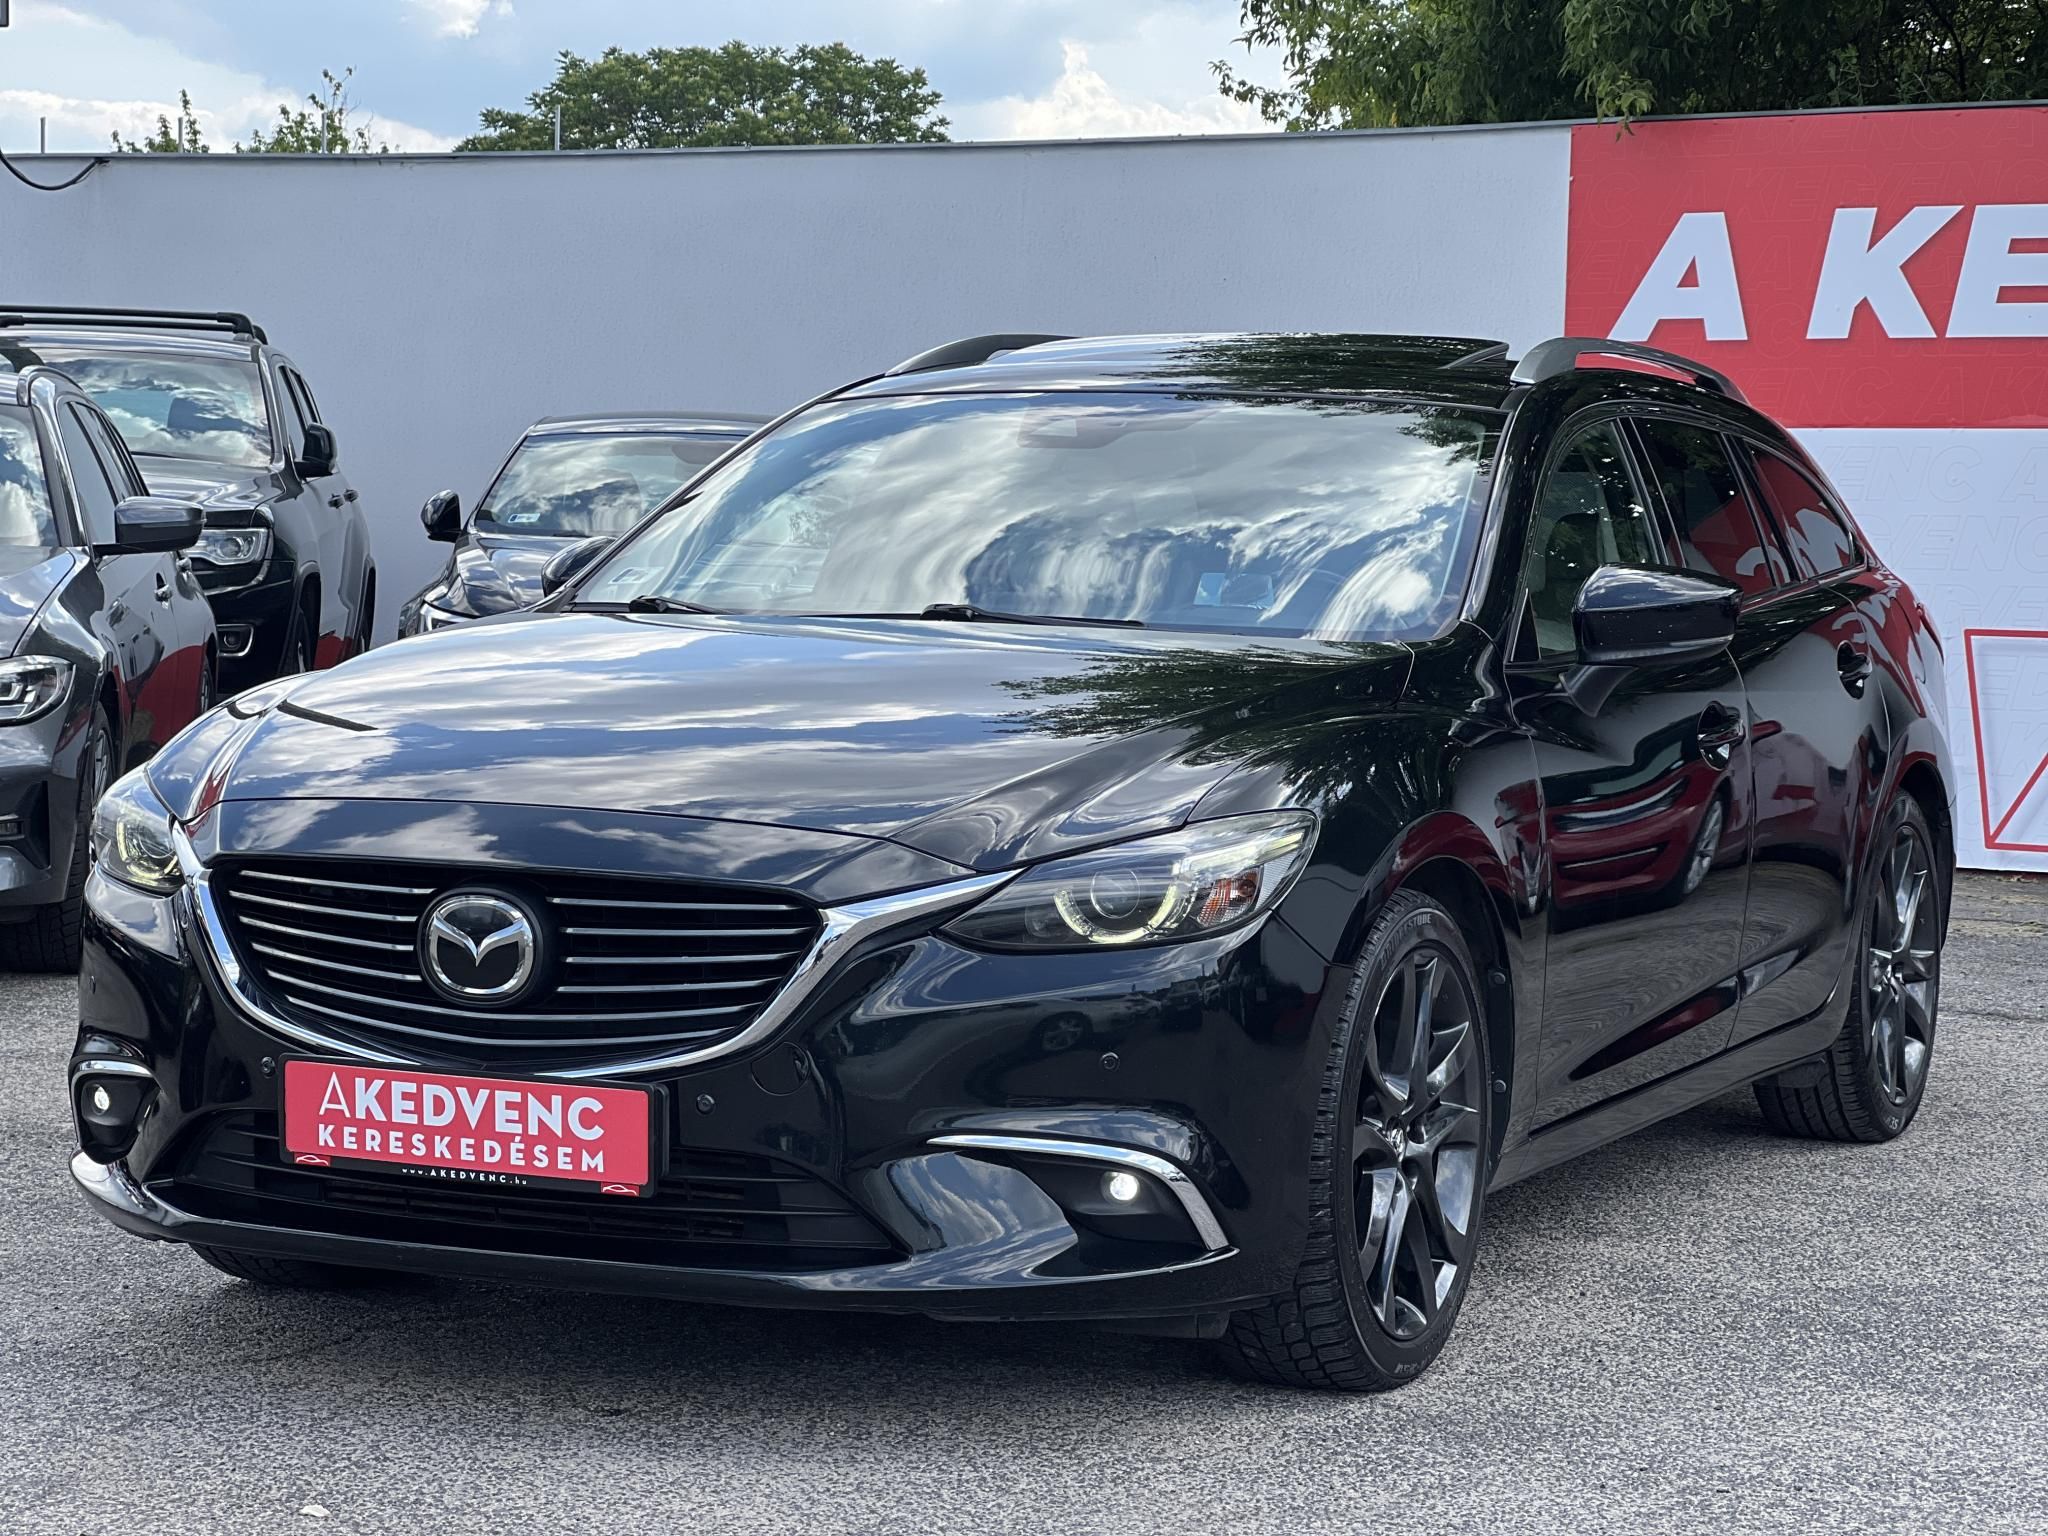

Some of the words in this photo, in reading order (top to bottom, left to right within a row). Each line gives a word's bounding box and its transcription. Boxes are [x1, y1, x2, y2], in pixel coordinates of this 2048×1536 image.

[1607, 211, 1749, 342] A
[1806, 203, 2048, 340] KE
[318, 1123, 605, 1174] KERESKEDÉSEM
[402, 1168, 527, 1185] www.AKEDVENC.hu
